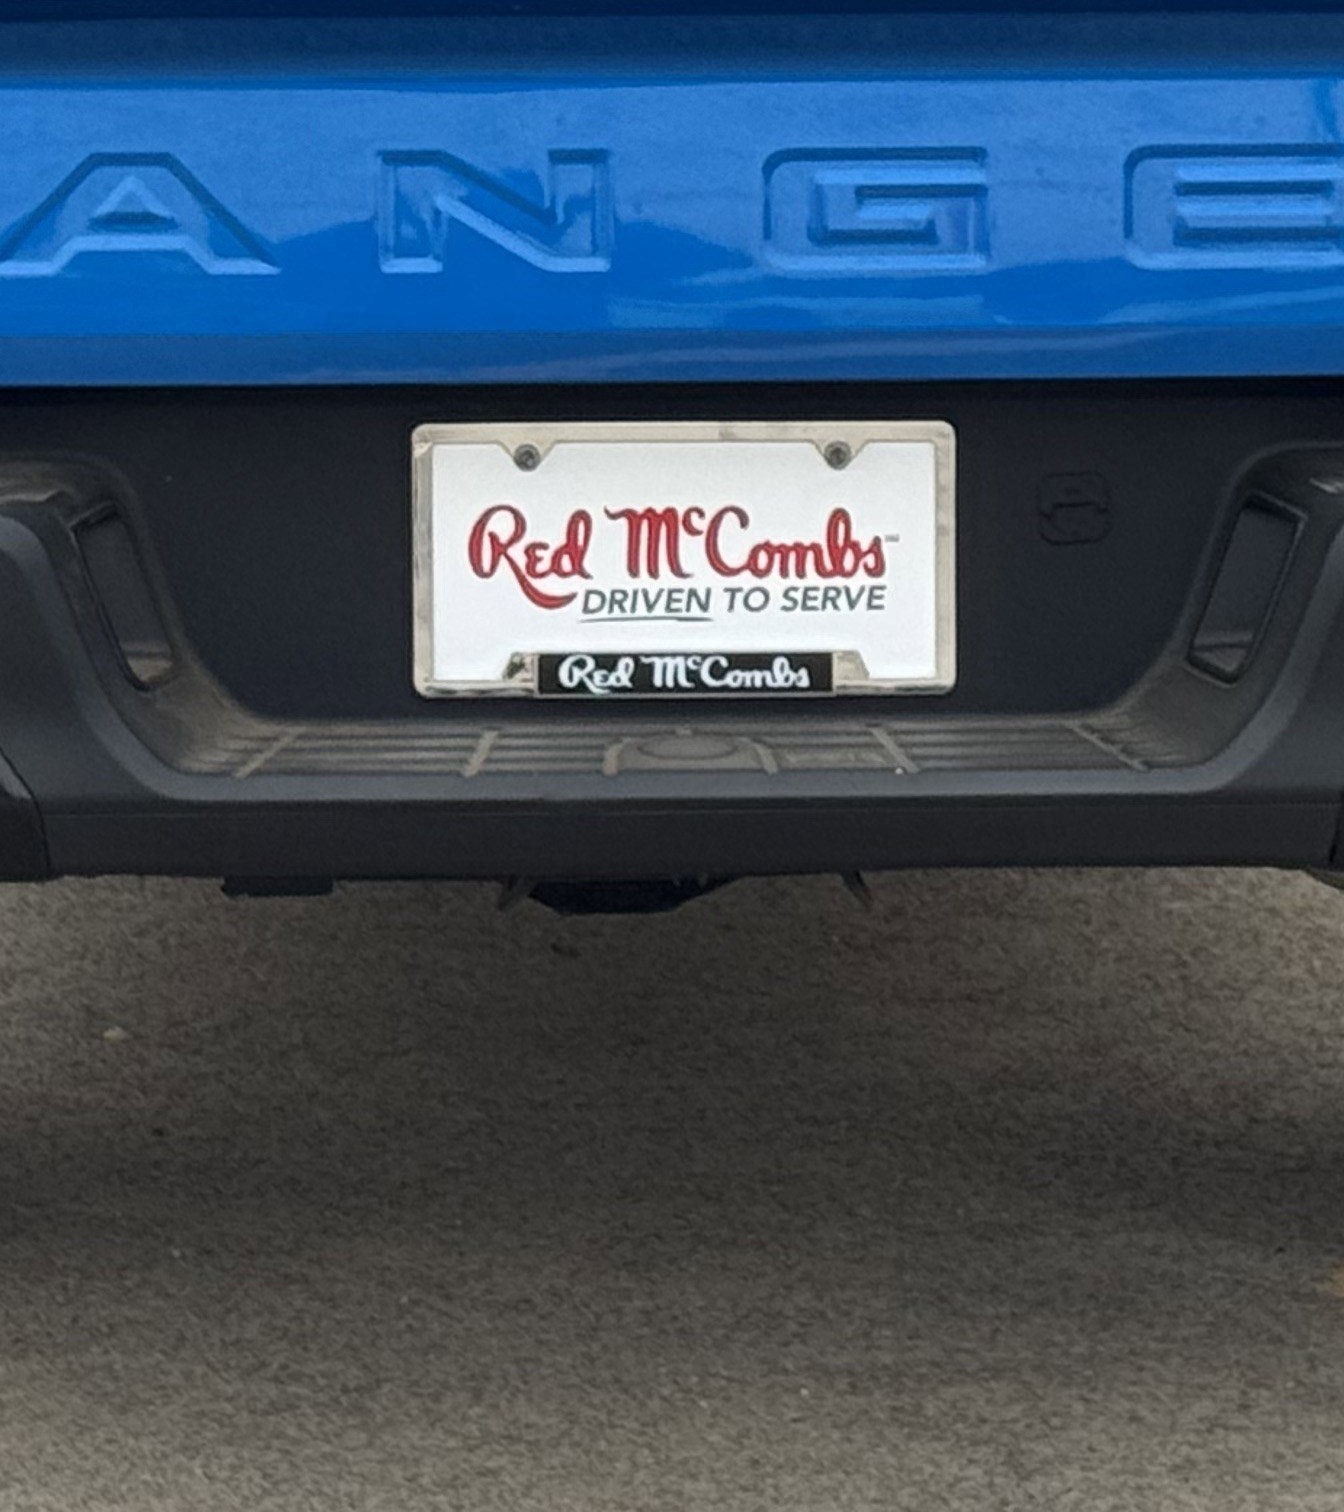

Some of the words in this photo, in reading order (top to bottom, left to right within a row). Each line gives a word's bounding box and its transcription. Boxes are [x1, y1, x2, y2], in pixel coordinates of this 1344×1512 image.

[468, 504, 594, 609] Red
[603, 504, 887, 580] McCombs
[581, 586, 712, 615] DRIVEN
[723, 585, 770, 613] TO
[779, 584, 887, 612] SERVE
[558, 654, 635, 694] Red
[639, 654, 811, 688] McCombs
